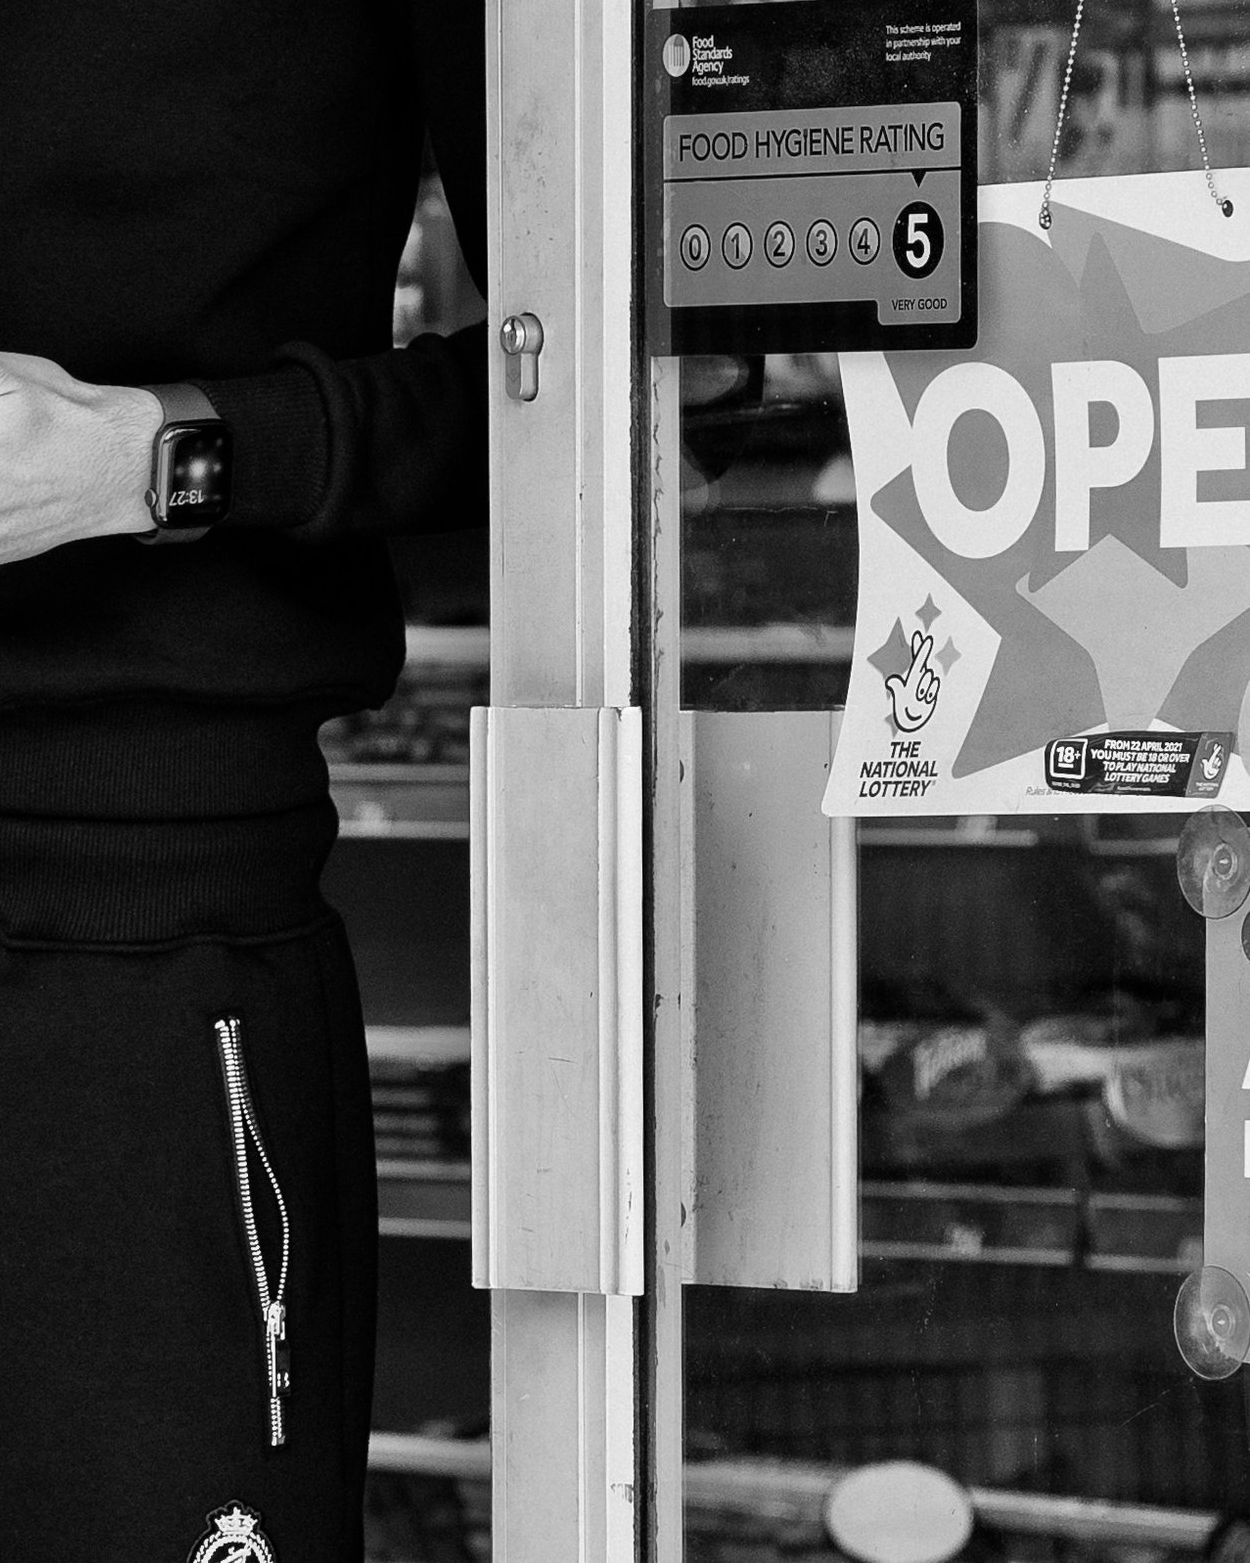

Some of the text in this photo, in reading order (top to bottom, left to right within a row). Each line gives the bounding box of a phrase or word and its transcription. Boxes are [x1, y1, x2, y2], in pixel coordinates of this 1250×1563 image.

[886, 21, 961, 35] This scheme is operated
[692, 34, 714, 48] Food
[886, 36, 961, 50] in partnership with your
[692, 46, 733, 60] Standards
[886, 50, 931, 62] local authority
[692, 59, 724, 75] Agency
[679, 122, 944, 162] FOOD HYGIENE RATING
[688, 213, 931, 269] 0 1 2 3 4 5
[892, 298, 948, 311] VERY GOOD
[890, 741, 922, 758] THE
[1104, 739, 1183, 753] FROM 22 APRIL 2021
[1056, 745, 1082, 764] 18+
[1091, 748, 1191, 764] YOU MUST BE 18 OR OVER
[859, 760, 939, 779] NATIONAL
[1103, 761, 1177, 774] TO PLAY NATIONAL
[1104, 771, 1170, 784] LOTTERY GAMES
